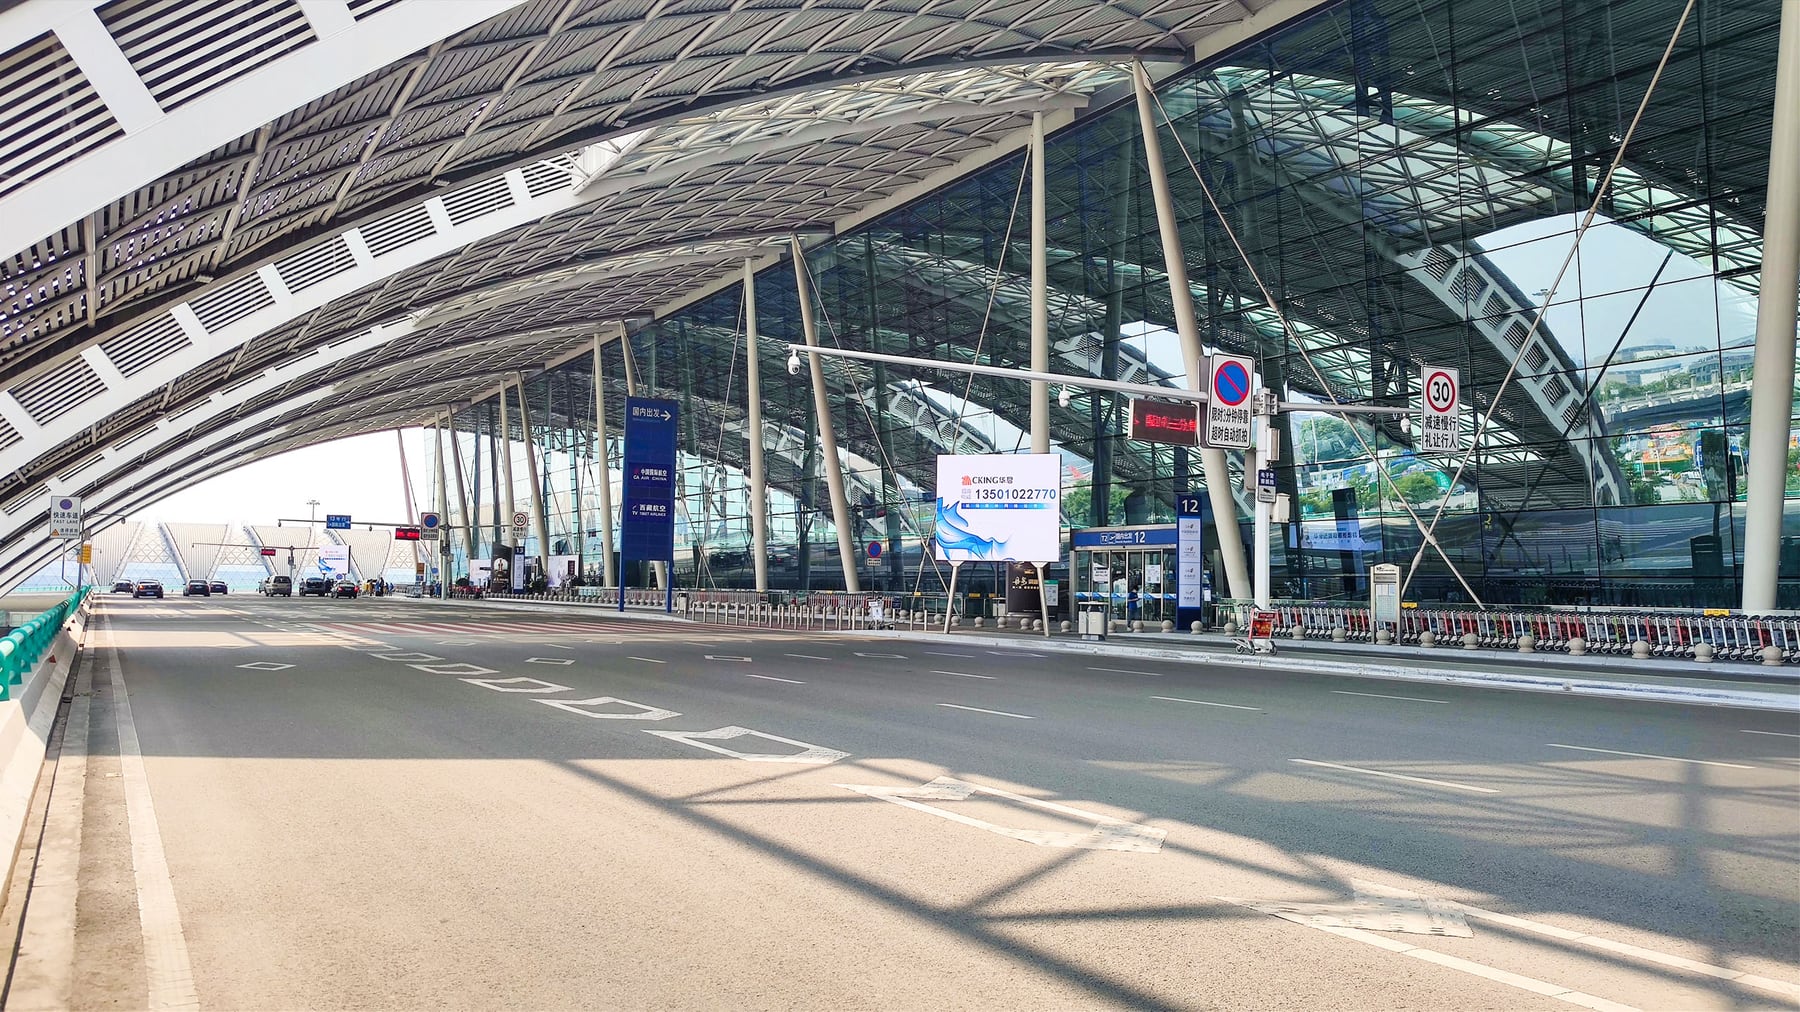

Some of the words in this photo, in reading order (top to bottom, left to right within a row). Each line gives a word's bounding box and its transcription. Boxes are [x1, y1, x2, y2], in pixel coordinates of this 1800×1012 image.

[1433, 381, 1450, 402] 30
[632, 406, 660, 418] 国内出发
[1425, 414, 1457, 431] 减速慢行
[1210, 426, 1248, 442] 超时自动抓拍
[1425, 432, 1457, 448] 礼让行人
[976, 488, 1056, 500] 13501022770
[1181, 499, 1199, 513] 12
[1134, 531, 1146, 543] 12
